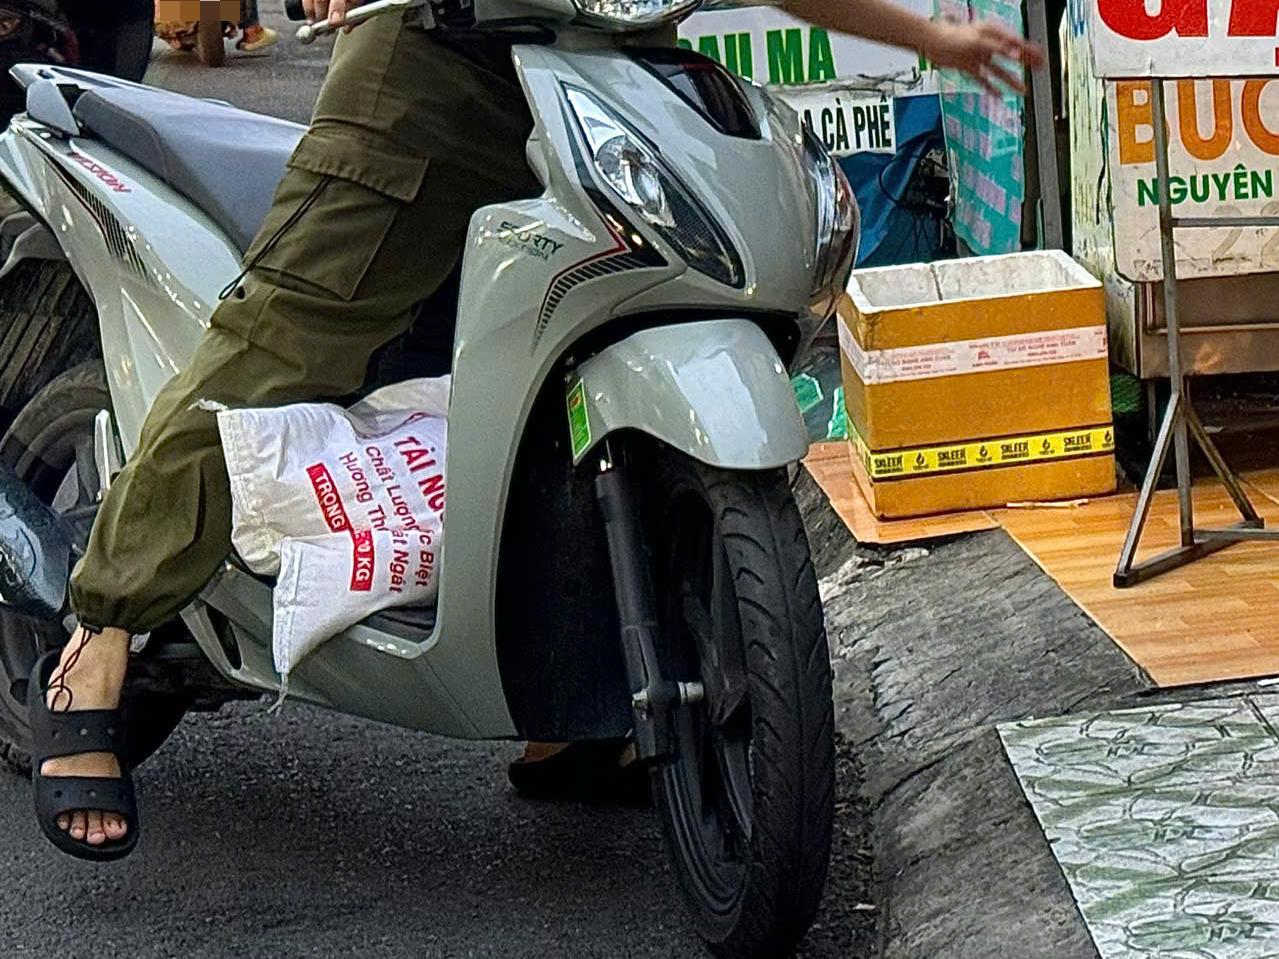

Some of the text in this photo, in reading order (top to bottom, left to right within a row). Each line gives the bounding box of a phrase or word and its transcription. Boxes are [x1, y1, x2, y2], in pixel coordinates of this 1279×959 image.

[821, 93, 893, 152] CÀ PHÊ
[1137, 162, 1273, 208] NGUYÊN
[355, 556, 372, 583] KG
